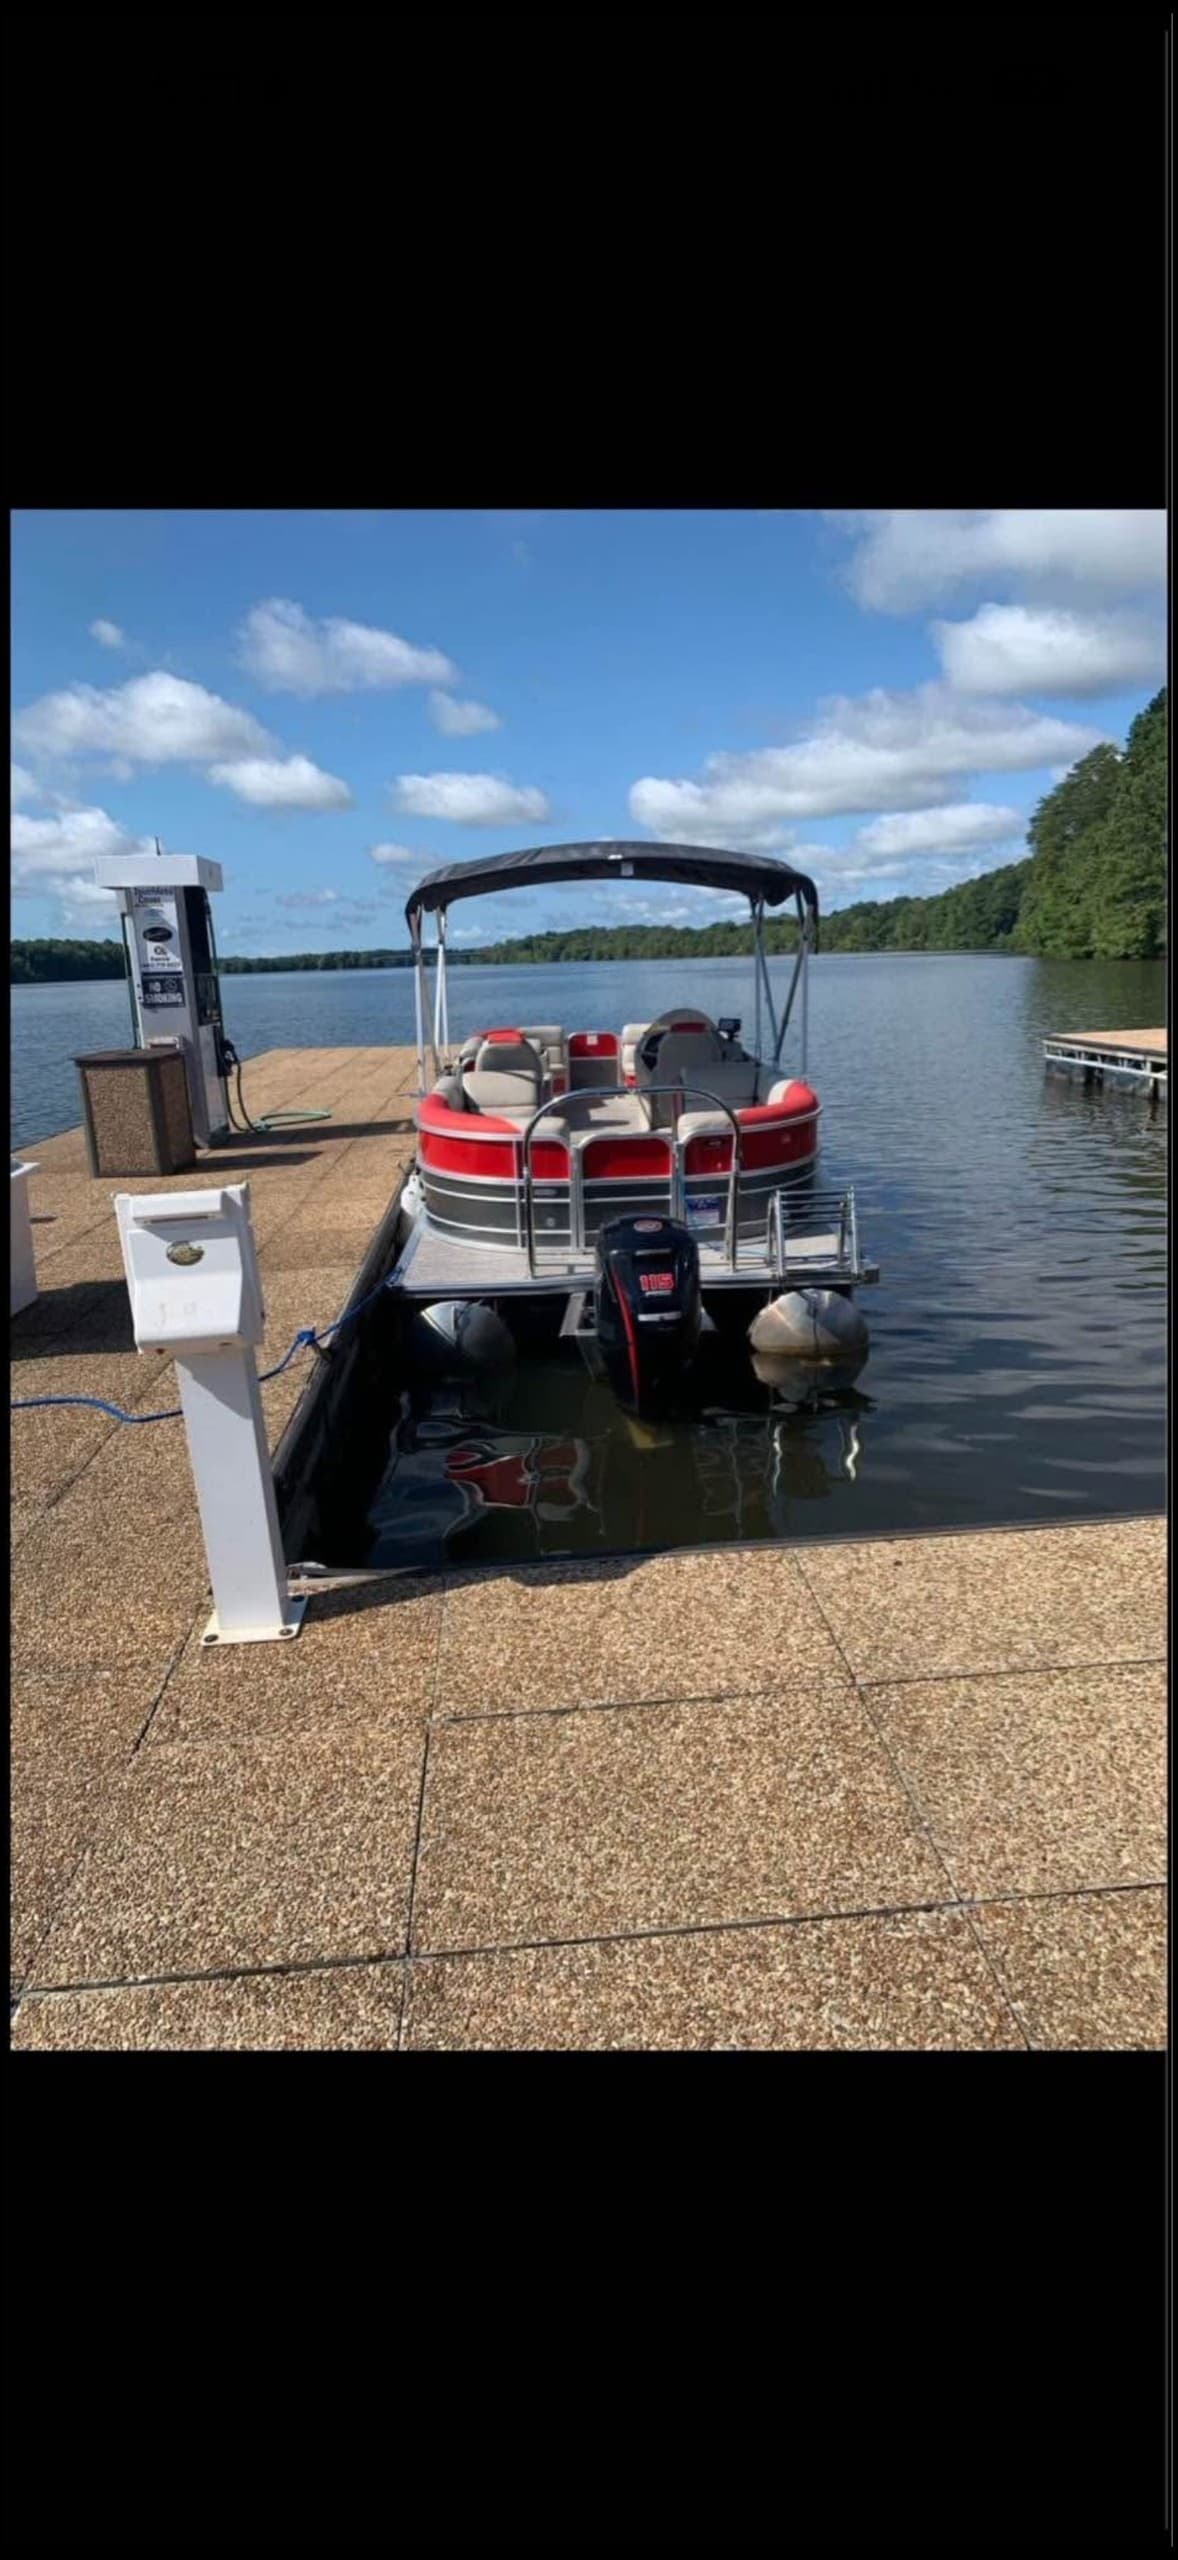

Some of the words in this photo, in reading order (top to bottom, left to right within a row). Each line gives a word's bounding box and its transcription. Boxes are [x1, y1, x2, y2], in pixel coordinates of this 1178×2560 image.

[148, 981, 162, 993] NO
[145, 993, 182, 1003] SMOKING
[639, 1273, 674, 1291] 115
